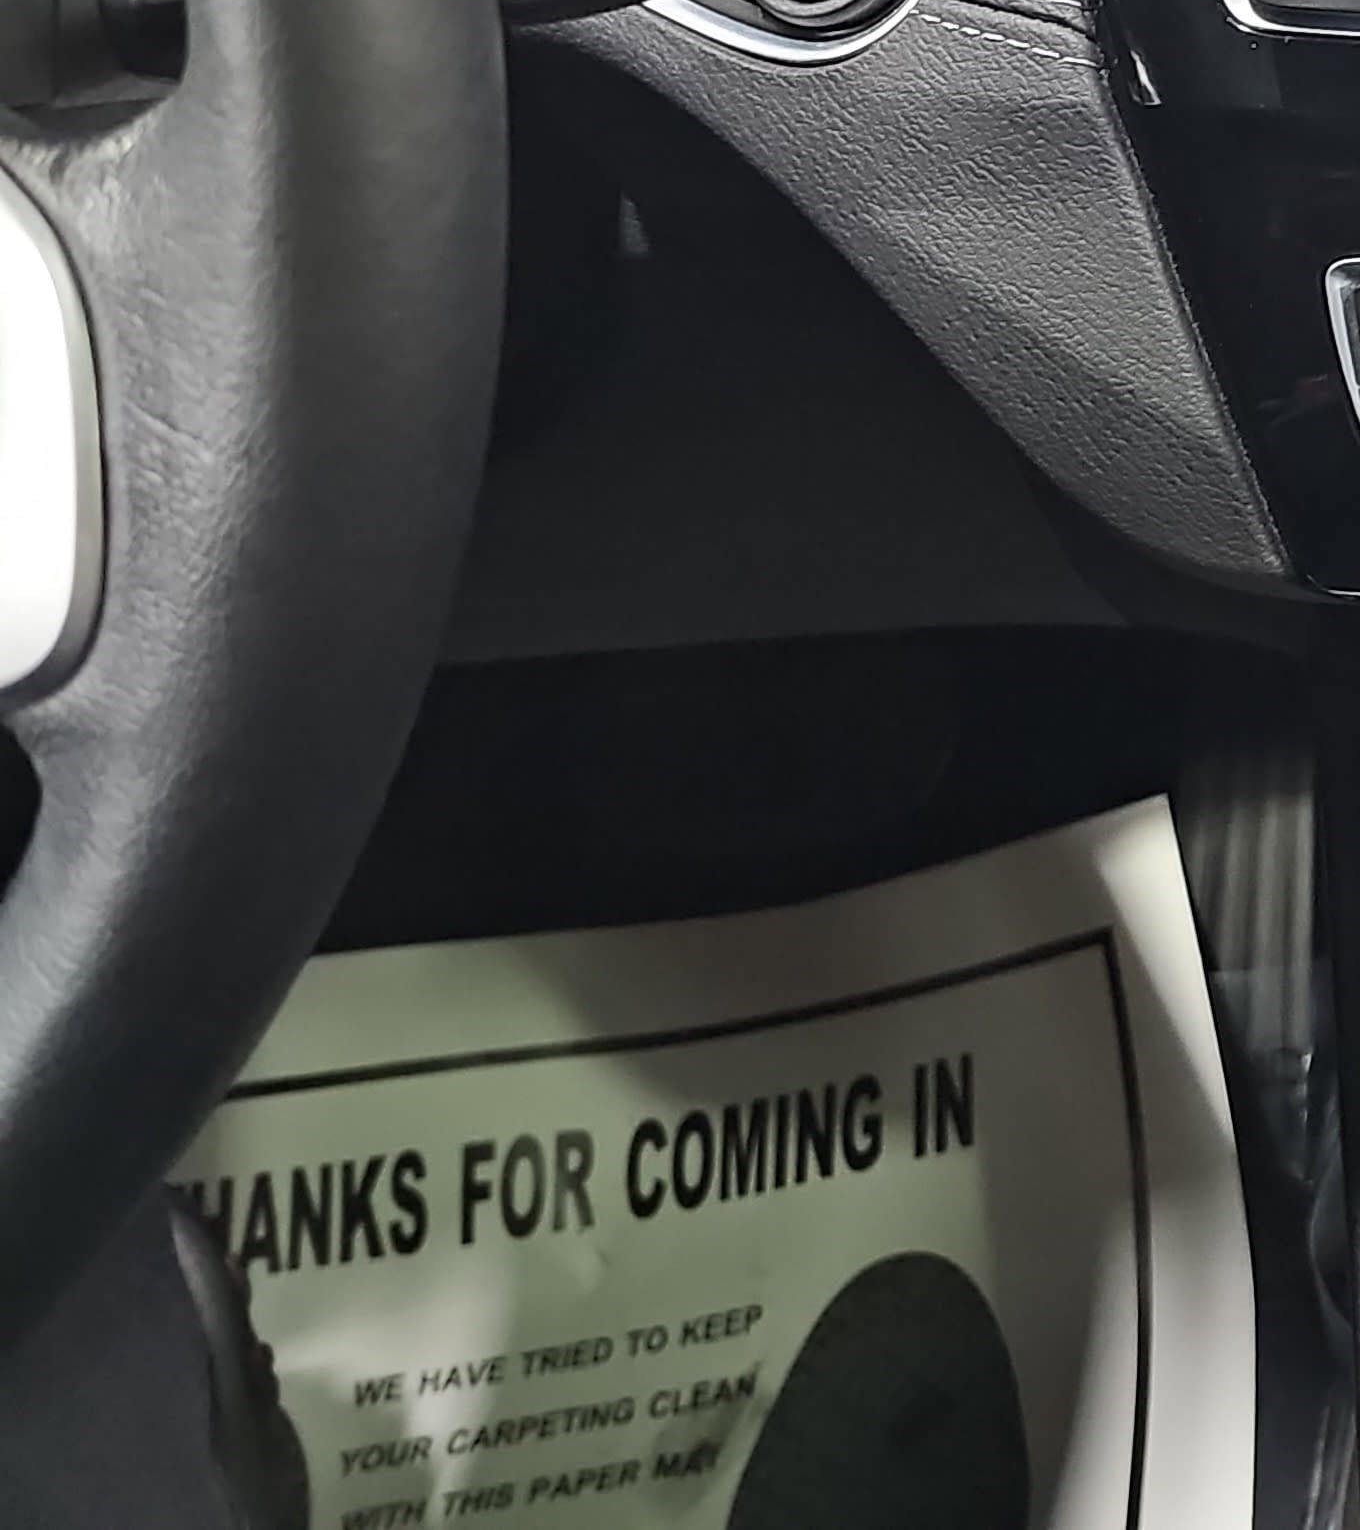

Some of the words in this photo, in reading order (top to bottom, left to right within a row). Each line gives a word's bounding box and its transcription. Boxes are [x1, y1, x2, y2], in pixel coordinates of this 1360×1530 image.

[166, 1148, 427, 1274] HANKS
[461, 1128, 595, 1246] FOR
[626, 1073, 884, 1220] COMING
[914, 1052, 975, 1159] IN
[352, 1372, 404, 1408] WE
[418, 1354, 507, 1396] HAVE
[520, 1335, 614, 1380] TRIED
[625, 1324, 670, 1358] TO
[678, 1304, 764, 1348] KEEP
[338, 1435, 434, 1478] YOUR
[446, 1395, 636, 1456] CARPETING
[649, 1364, 760, 1419] CLEAN
[441, 1480, 516, 1520] THIS
[525, 1459, 643, 1507] PAPER
